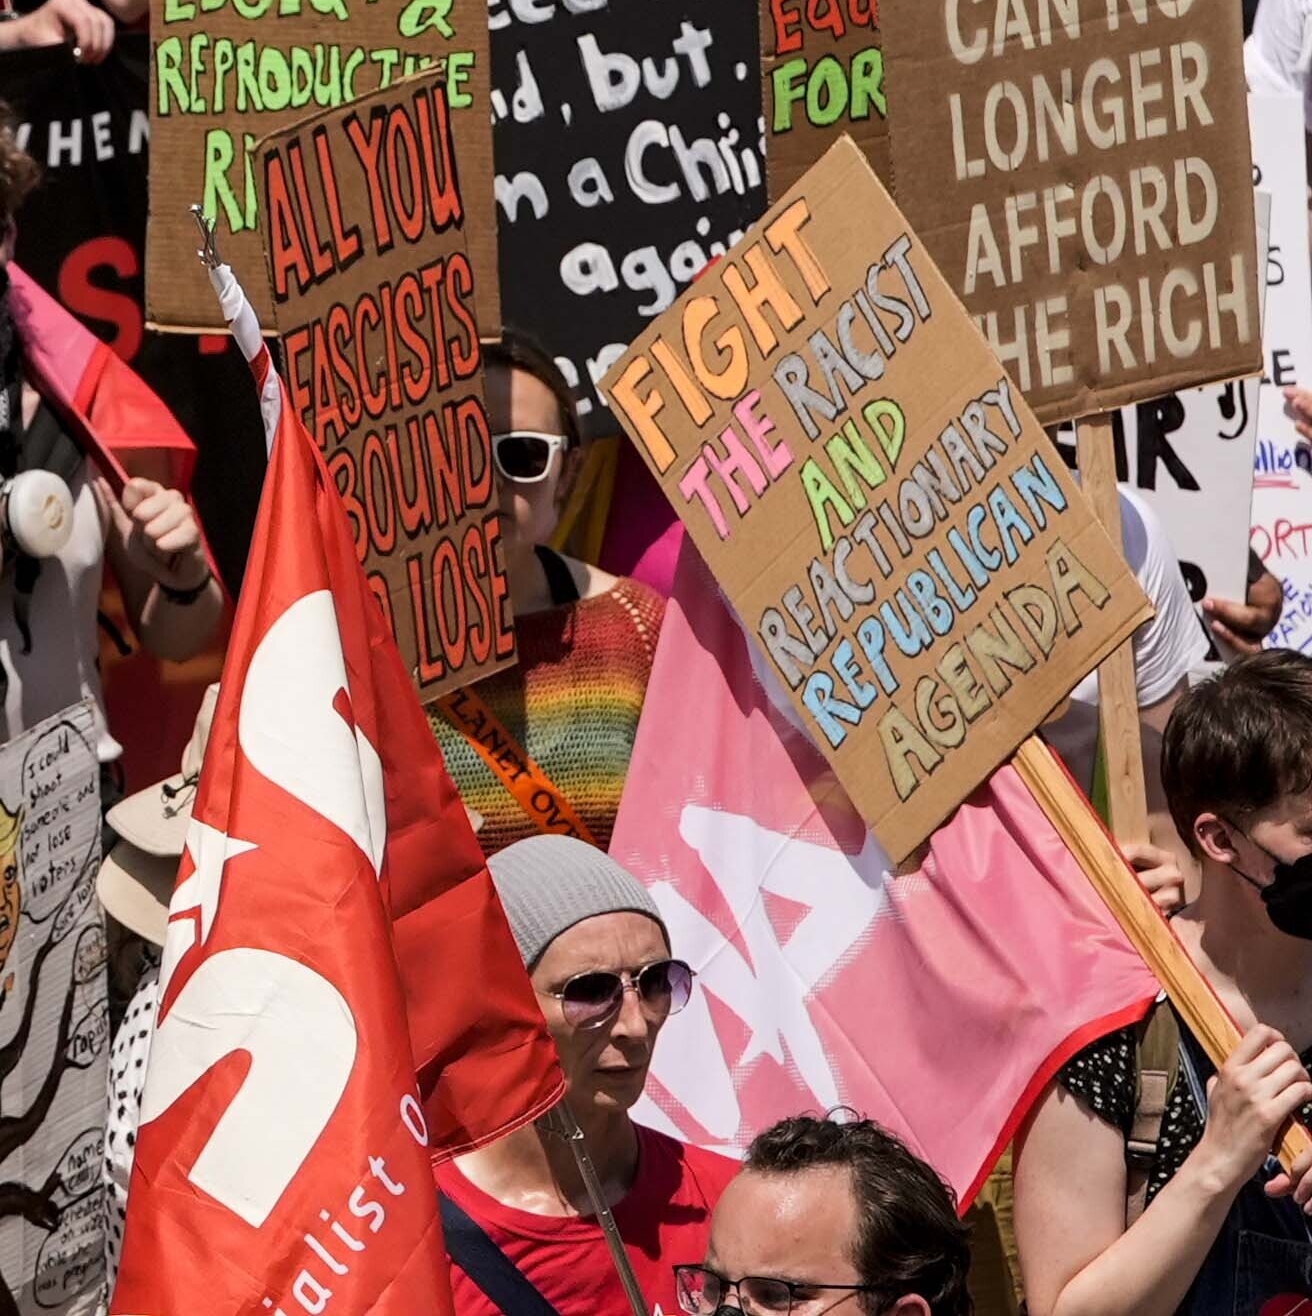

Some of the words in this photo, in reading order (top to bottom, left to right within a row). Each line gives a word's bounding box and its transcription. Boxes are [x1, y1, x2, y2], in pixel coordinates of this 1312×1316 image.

[263, 118, 364, 304] ALL
[343, 82, 466, 251] YOU
[566, 156, 615, 208] a
[947, 39, 1216, 182] LONGER
[962, 155, 1221, 297] AFFORD
[1092, 251, 1253, 377] RICH
[278, 251, 483, 456] FASCISTS
[611, 195, 833, 476] FIGHT
[679, 387, 797, 541] THE
[772, 232, 937, 444] RACIST
[330, 395, 497, 566] BOUND
[758, 377, 1025, 693] REACTIONARY
[799, 395, 909, 554] AND
[405, 510, 515, 689] LOSE
[800, 449, 1071, 750] REPUBLICAN
[875, 537, 1113, 804] AGENDA
[47, 824, 73, 853] lose
